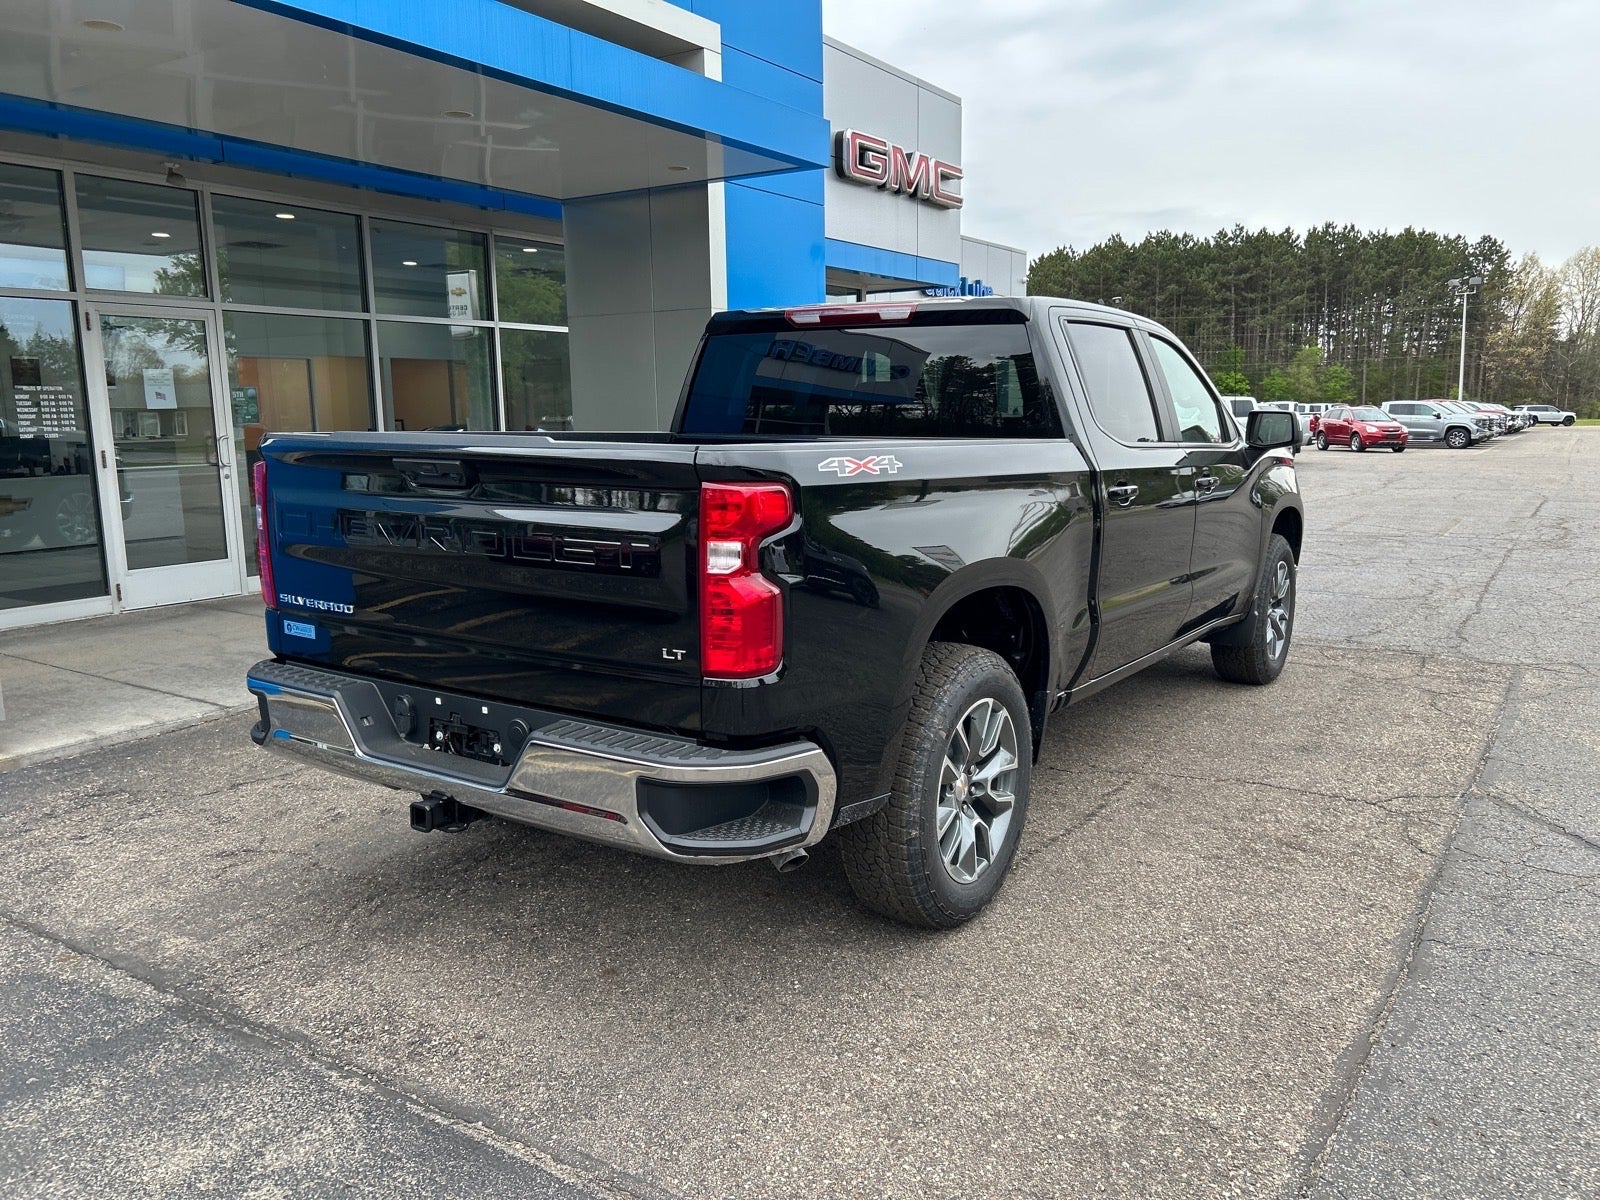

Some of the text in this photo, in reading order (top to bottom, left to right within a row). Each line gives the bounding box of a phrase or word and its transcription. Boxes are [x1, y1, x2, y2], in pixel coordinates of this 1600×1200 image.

[842, 128, 964, 209] GMC
[279, 593, 355, 614] SILVERADO
[662, 647, 687, 661] LT
